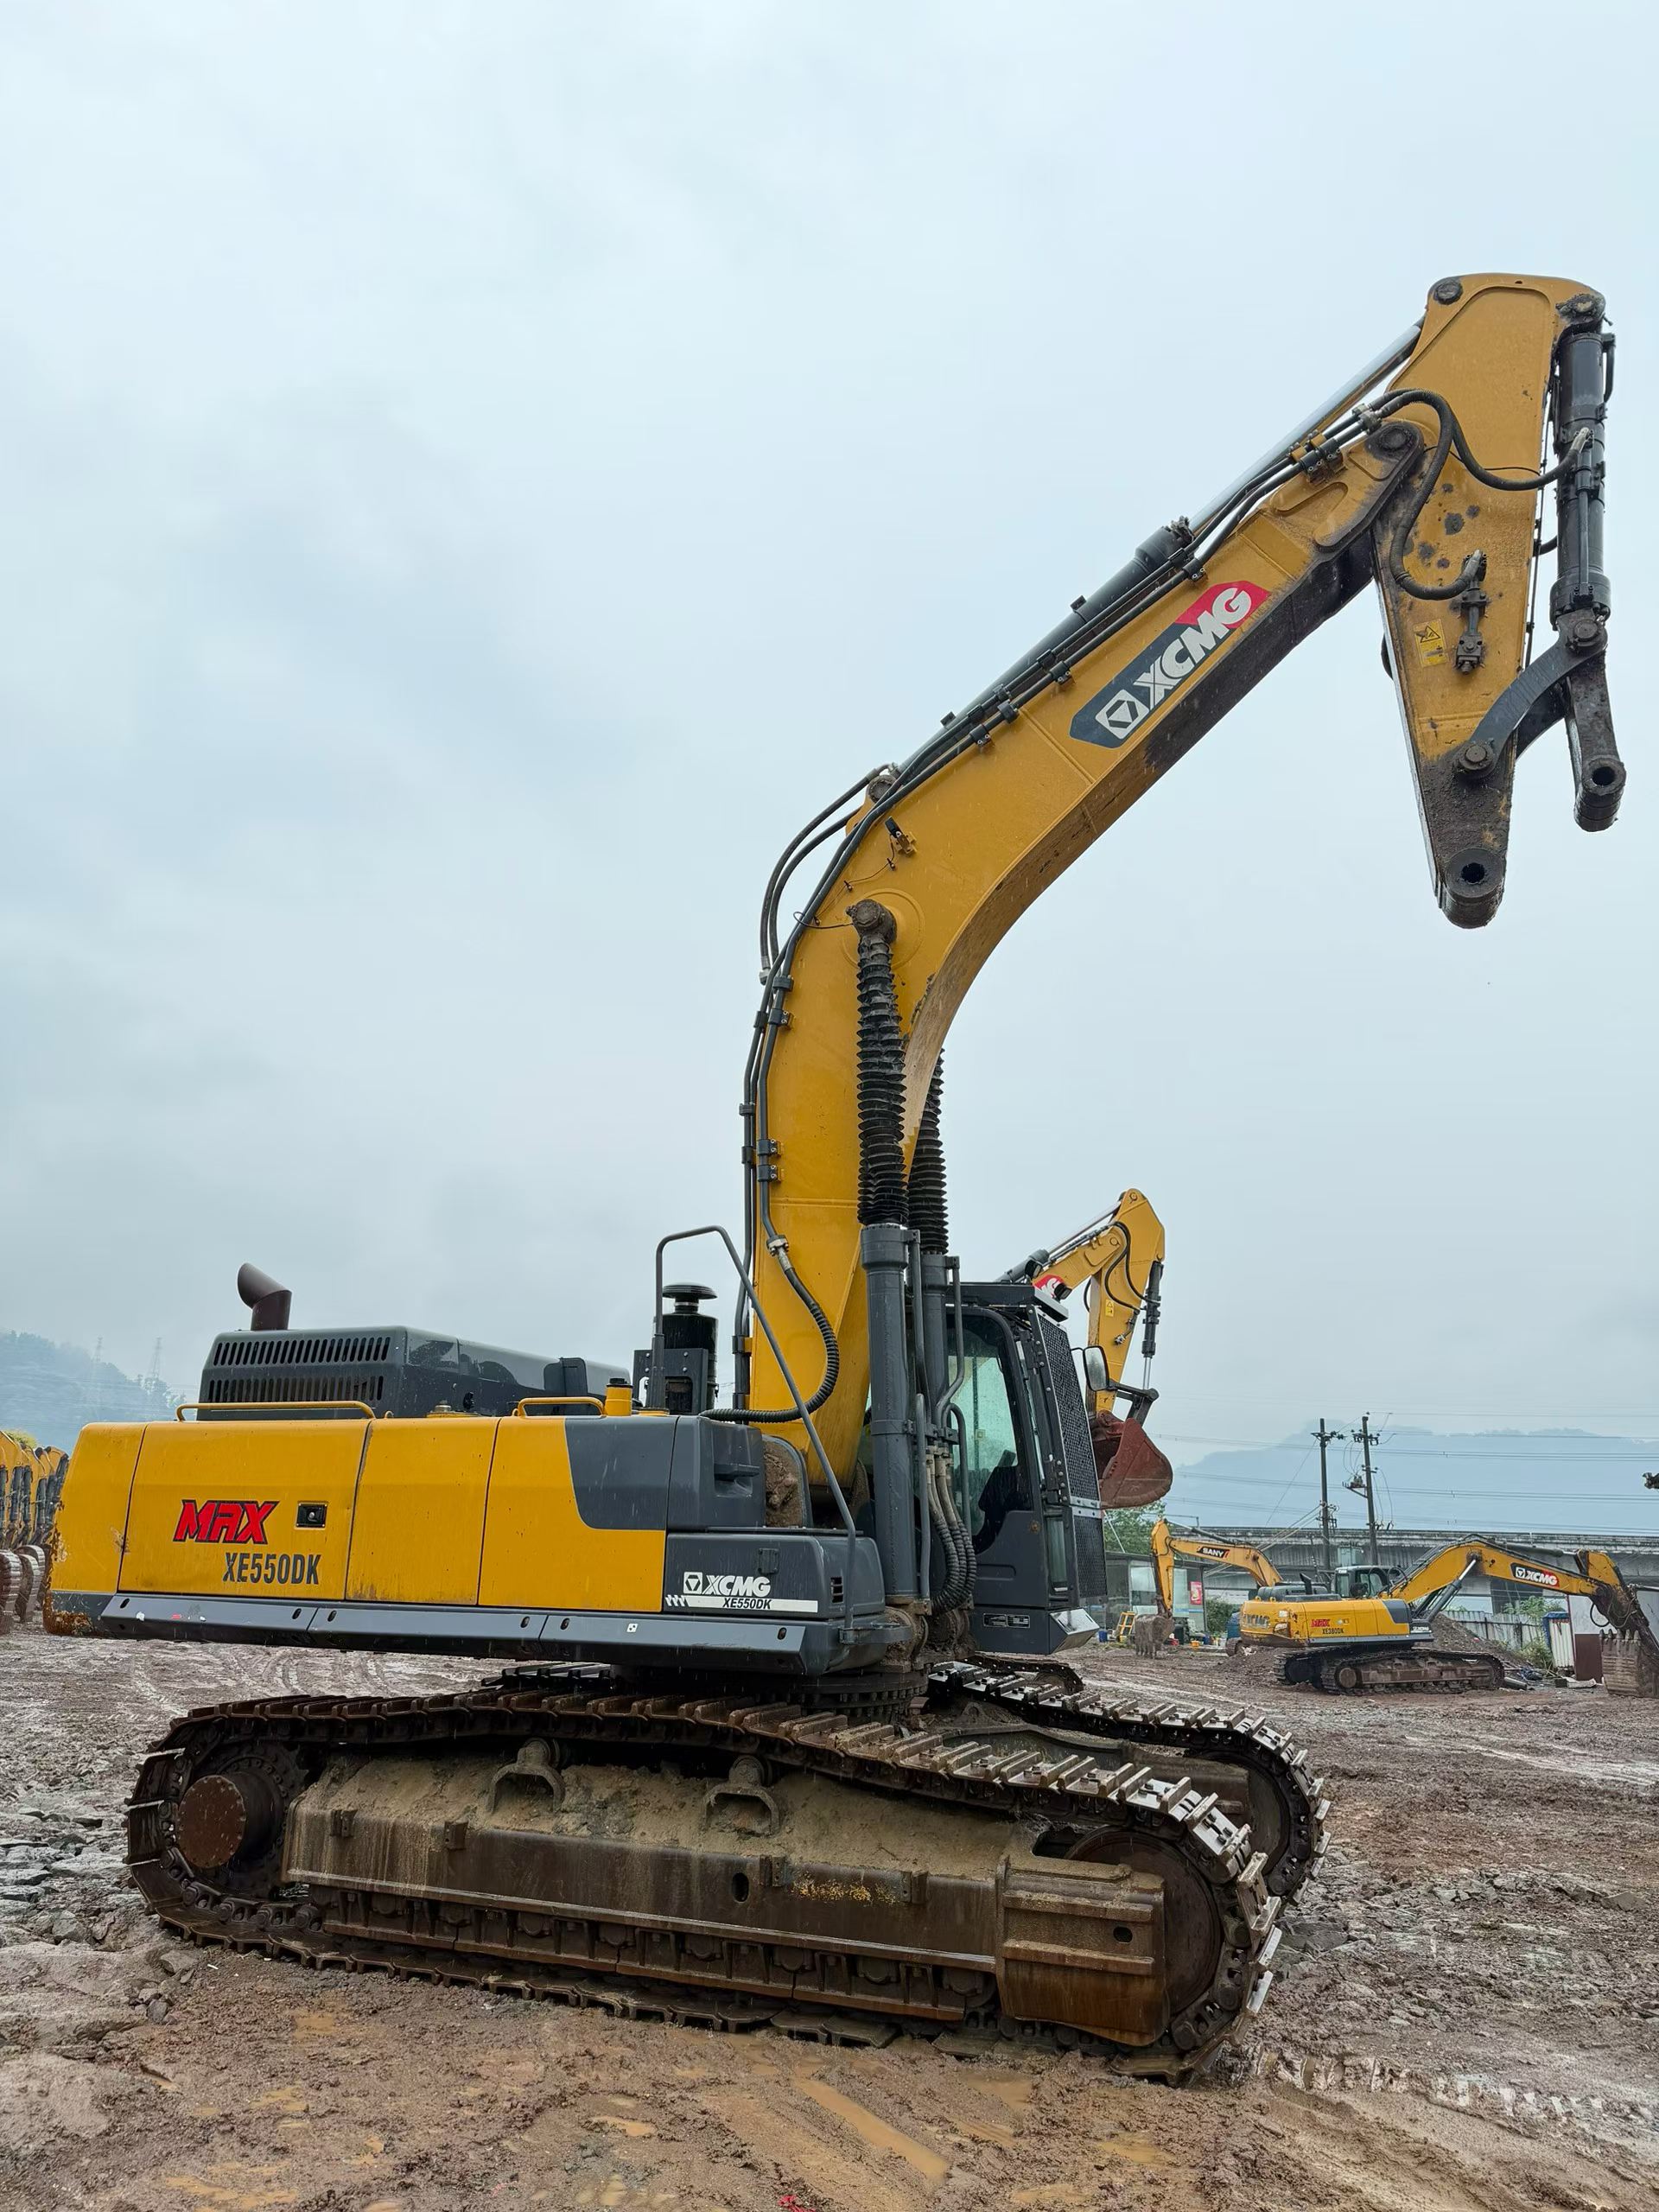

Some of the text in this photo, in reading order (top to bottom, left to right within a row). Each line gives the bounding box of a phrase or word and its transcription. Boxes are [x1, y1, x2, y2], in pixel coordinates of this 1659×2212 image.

[1133, 588, 1252, 710] XCMG
[173, 1499, 280, 1544] MAX
[1202, 1548, 1224, 1557] SANY
[223, 1552, 321, 1585] XE550DK
[1526, 1570, 1558, 1586] XCMG
[702, 1575, 772, 1597] XCMG
[722, 1598, 772, 1610] XE550DK
